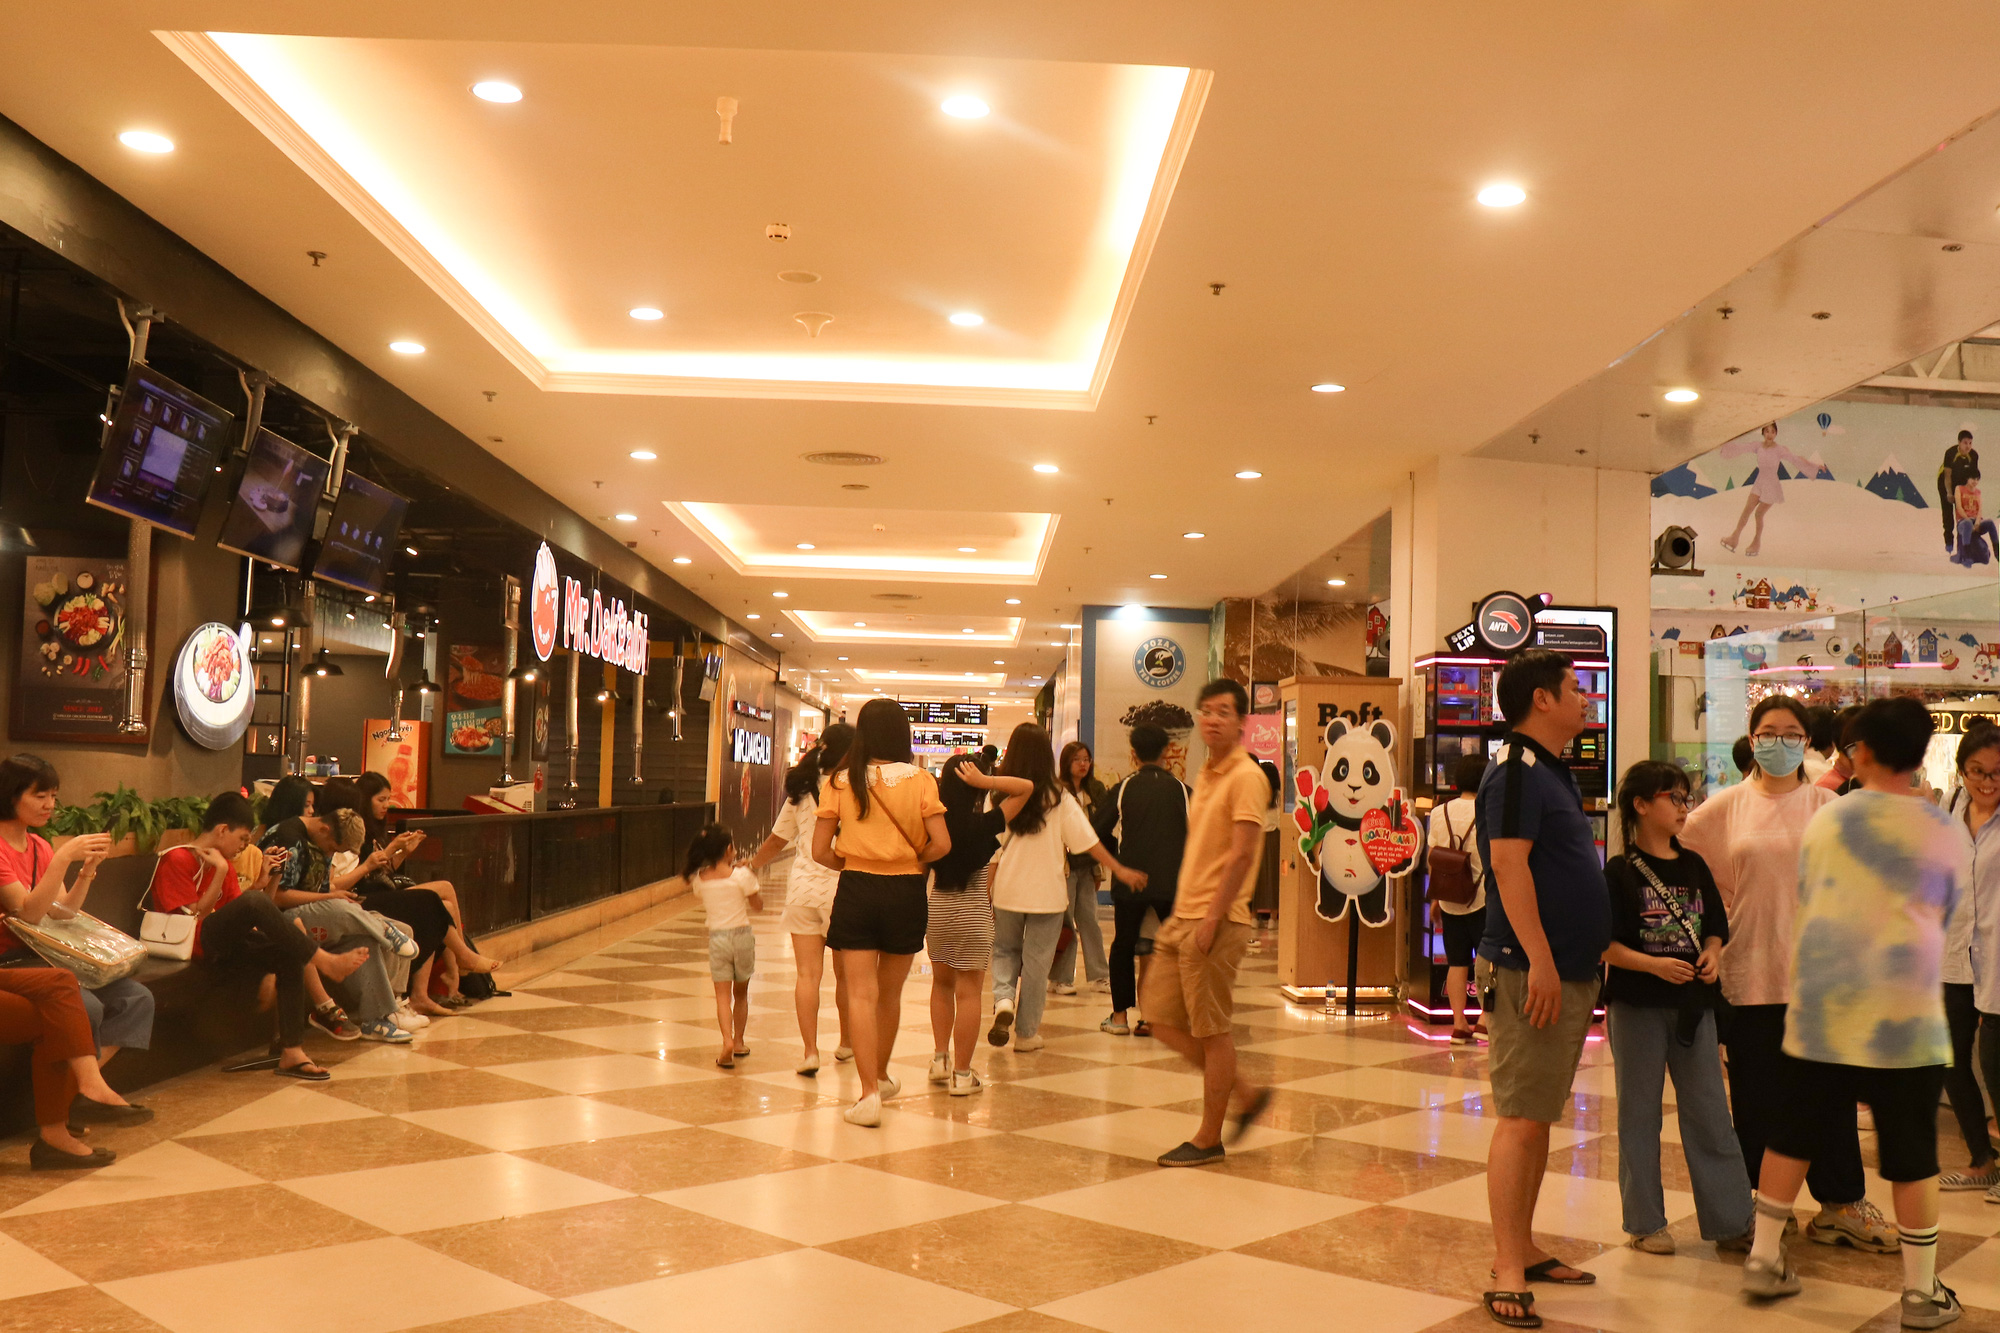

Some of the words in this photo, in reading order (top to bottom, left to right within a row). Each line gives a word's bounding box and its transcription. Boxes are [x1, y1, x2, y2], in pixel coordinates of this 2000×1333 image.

[1451, 624, 1475, 643] SEXY
[1488, 621, 1508, 632] ANTA
[1143, 639, 1176, 653] POZAA
[1456, 635, 1476, 651] LIP
[1139, 668, 1150, 682] TEA
[1157, 670, 1180, 686] COFFEE
[1317, 702, 1383, 727] Boft
[1391, 832, 1415, 845] GAME
